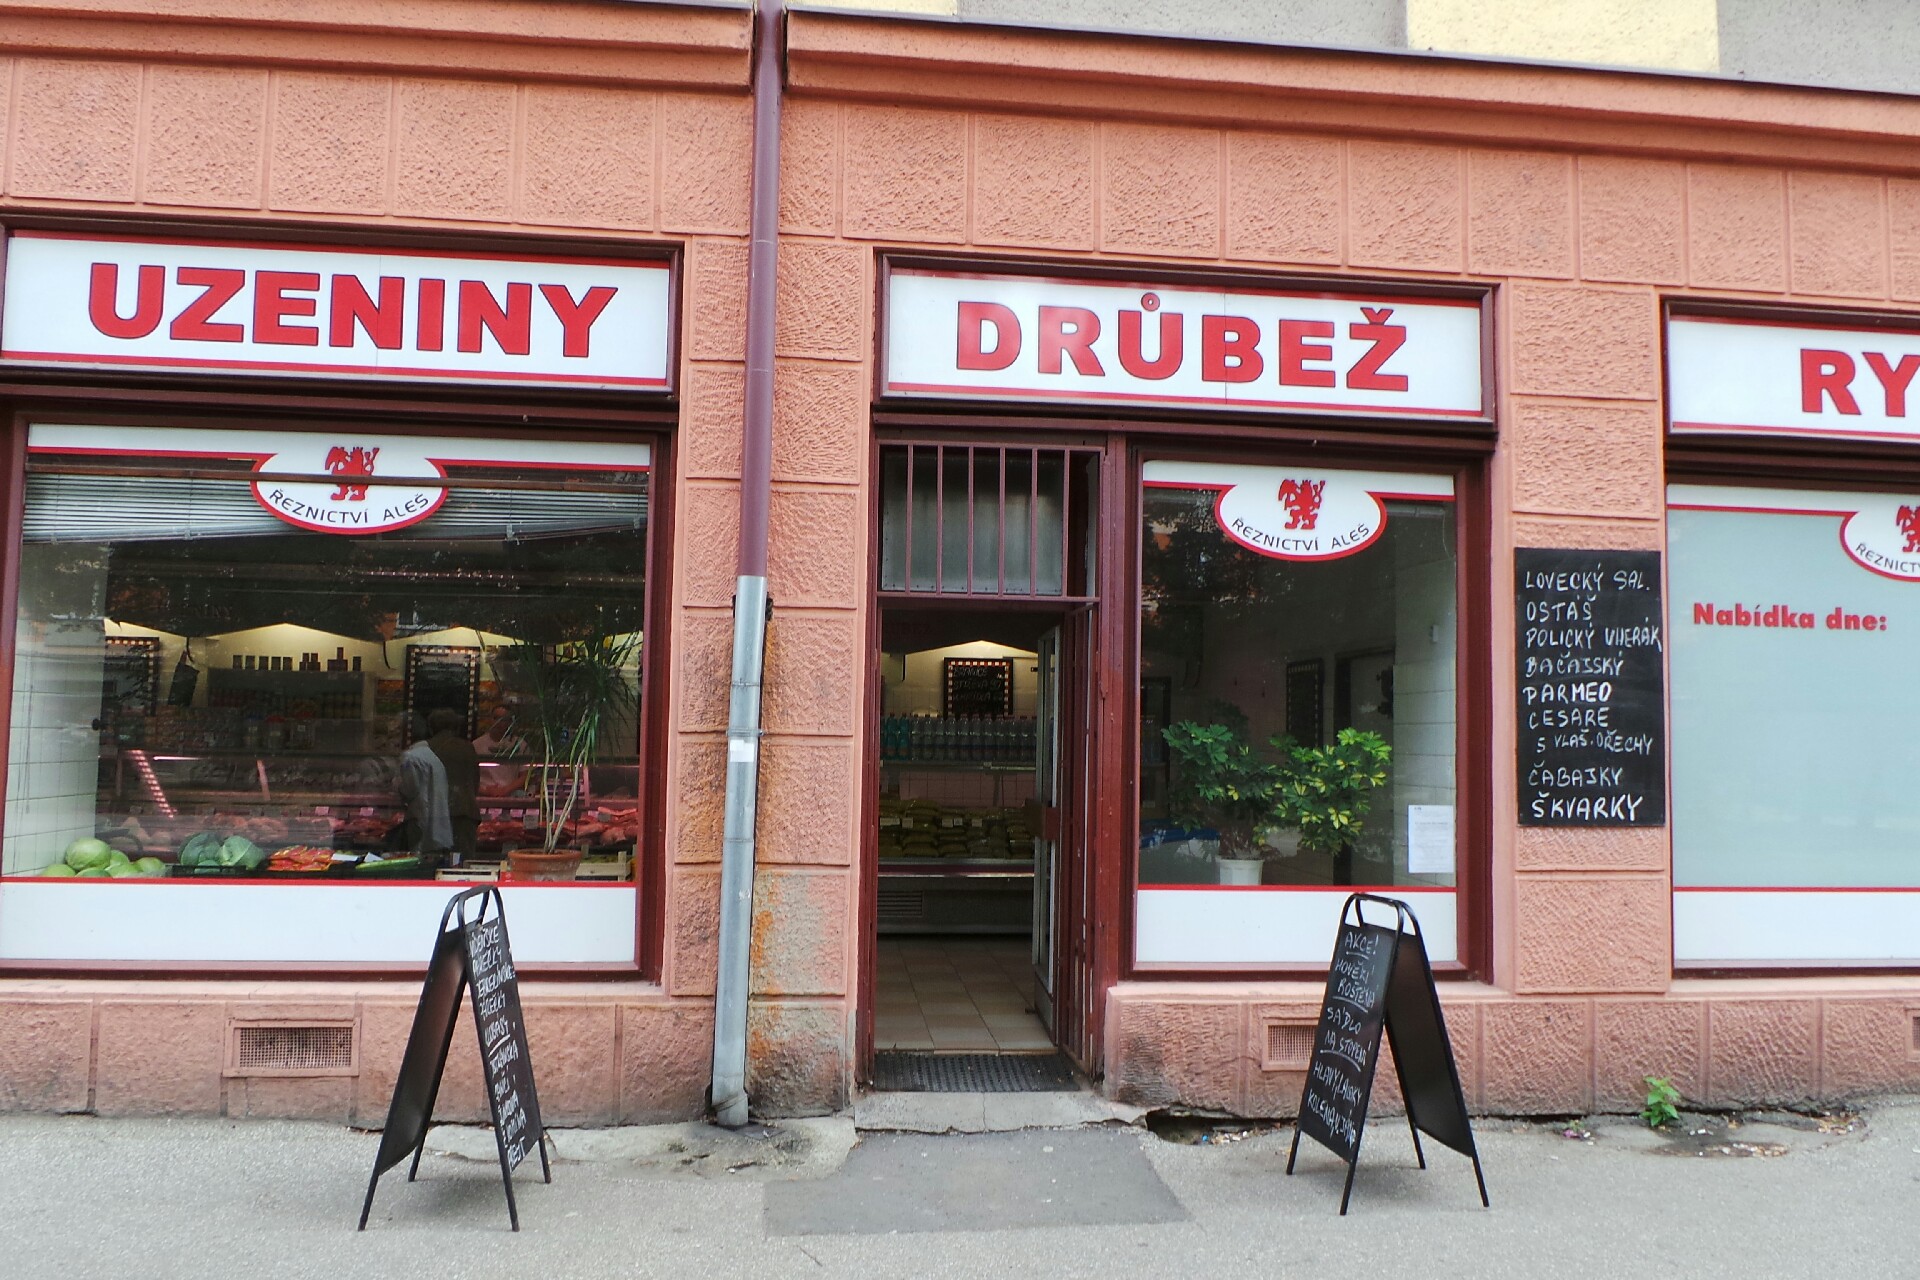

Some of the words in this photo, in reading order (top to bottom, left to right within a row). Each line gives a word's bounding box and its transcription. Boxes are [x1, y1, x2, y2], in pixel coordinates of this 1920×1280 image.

[88, 261, 619, 358] UZENINY
[956, 292, 1409, 392] DRŮBEŽ
[1799, 348, 1920, 418] RY
[267, 488, 371, 524] ŘEZNICTVÍ
[382, 493, 431, 521] ALEŠ
[1232, 517, 1320, 552] ŘEZNICTVÍ
[1331, 522, 1371, 551] ALEŠ
[1855, 542, 1920, 573] ŘEZNICT
[1525, 562, 1604, 591] LOVECKÝ
[1613, 570, 1650, 590] SAL.
[1693, 602, 1815, 629] Nabídka
[1826, 607, 1888, 631] dne:
[1529, 707, 1610, 730] CESARE
[1528, 760, 1623, 787] ČABAJKY
[1531, 791, 1643, 822] ŠKVARKY
[1344, 931, 1379, 955] AKCE!
